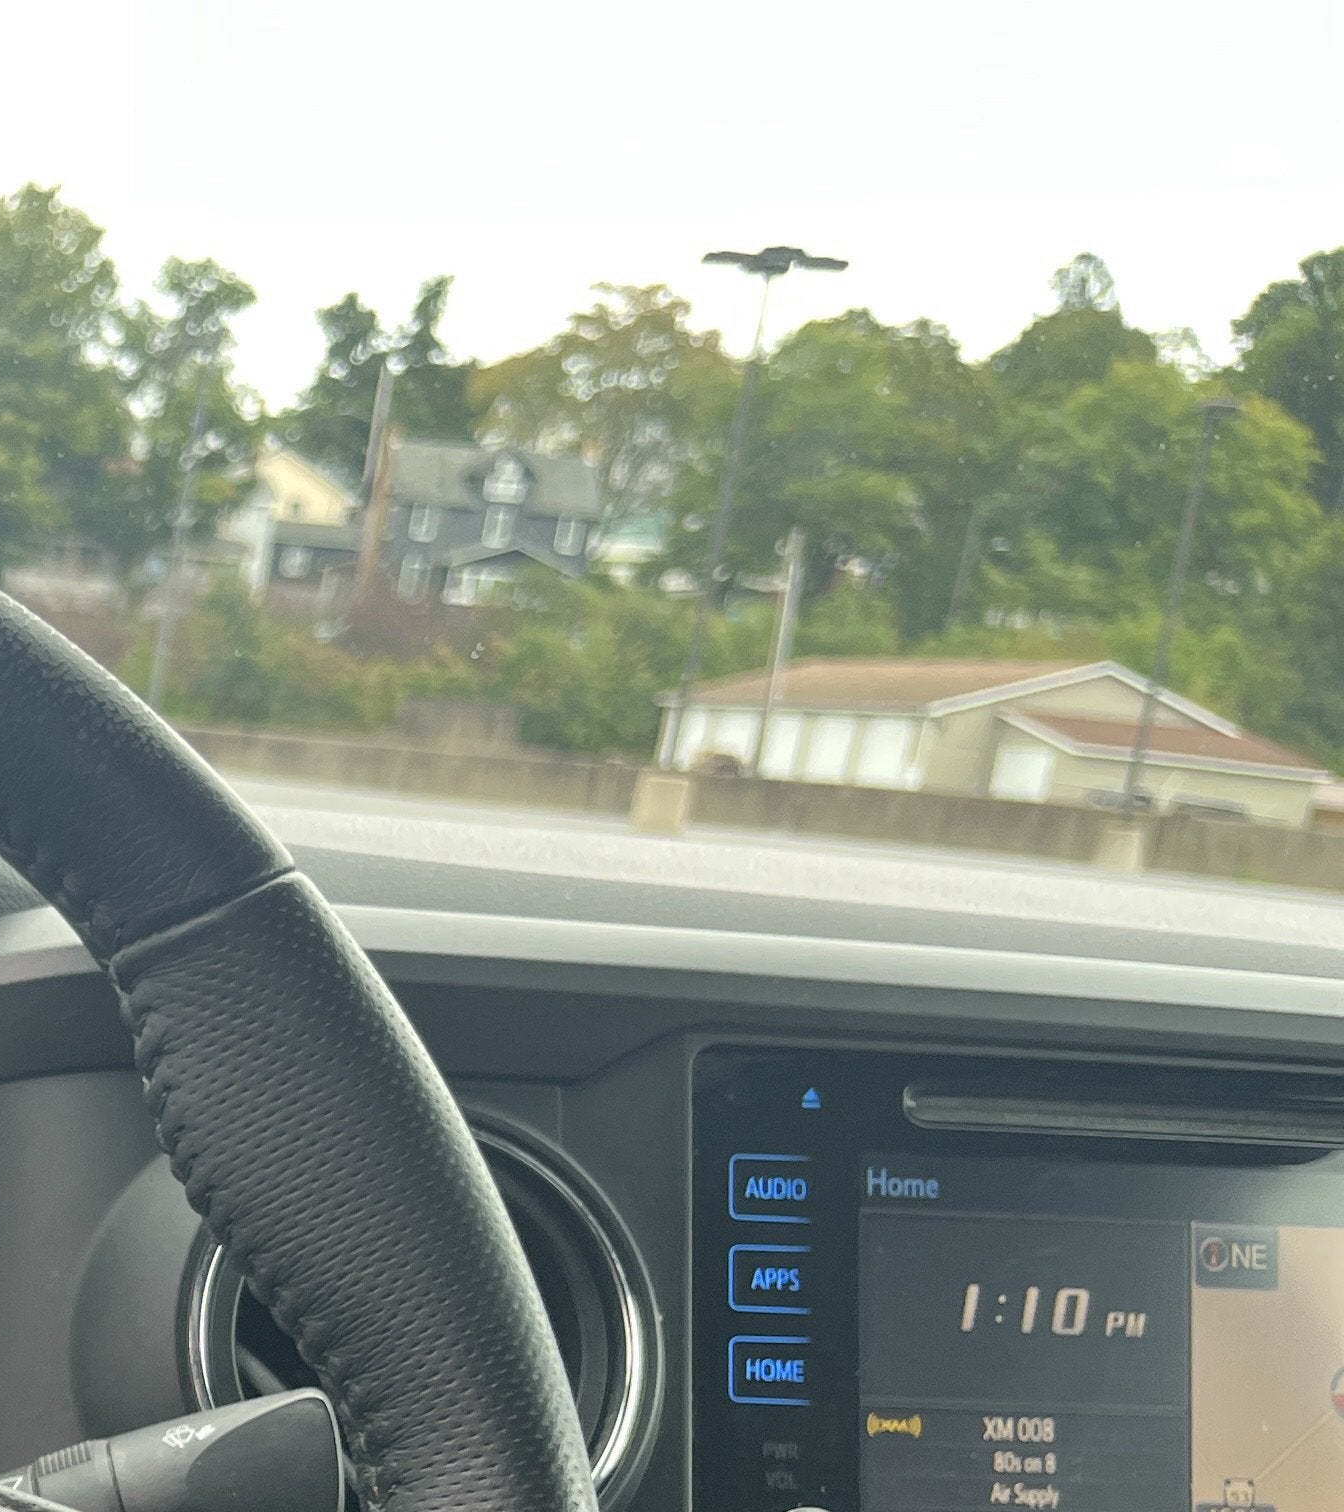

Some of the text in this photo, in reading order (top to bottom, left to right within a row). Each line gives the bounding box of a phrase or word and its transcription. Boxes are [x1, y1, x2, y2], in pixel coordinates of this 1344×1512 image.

[745, 1176, 808, 1201] AUDIO
[867, 1167, 940, 1199] Home
[751, 1267, 801, 1291] APPS
[960, 1283, 1146, 1338] 1:10 PM
[745, 1358, 805, 1383] HOME
[982, 1416, 1055, 1443] XM 008
[1023, 1457, 1042, 1473] on
[1045, 1452, 1056, 1474] 8
[1014, 1482, 1059, 1510] Supply
